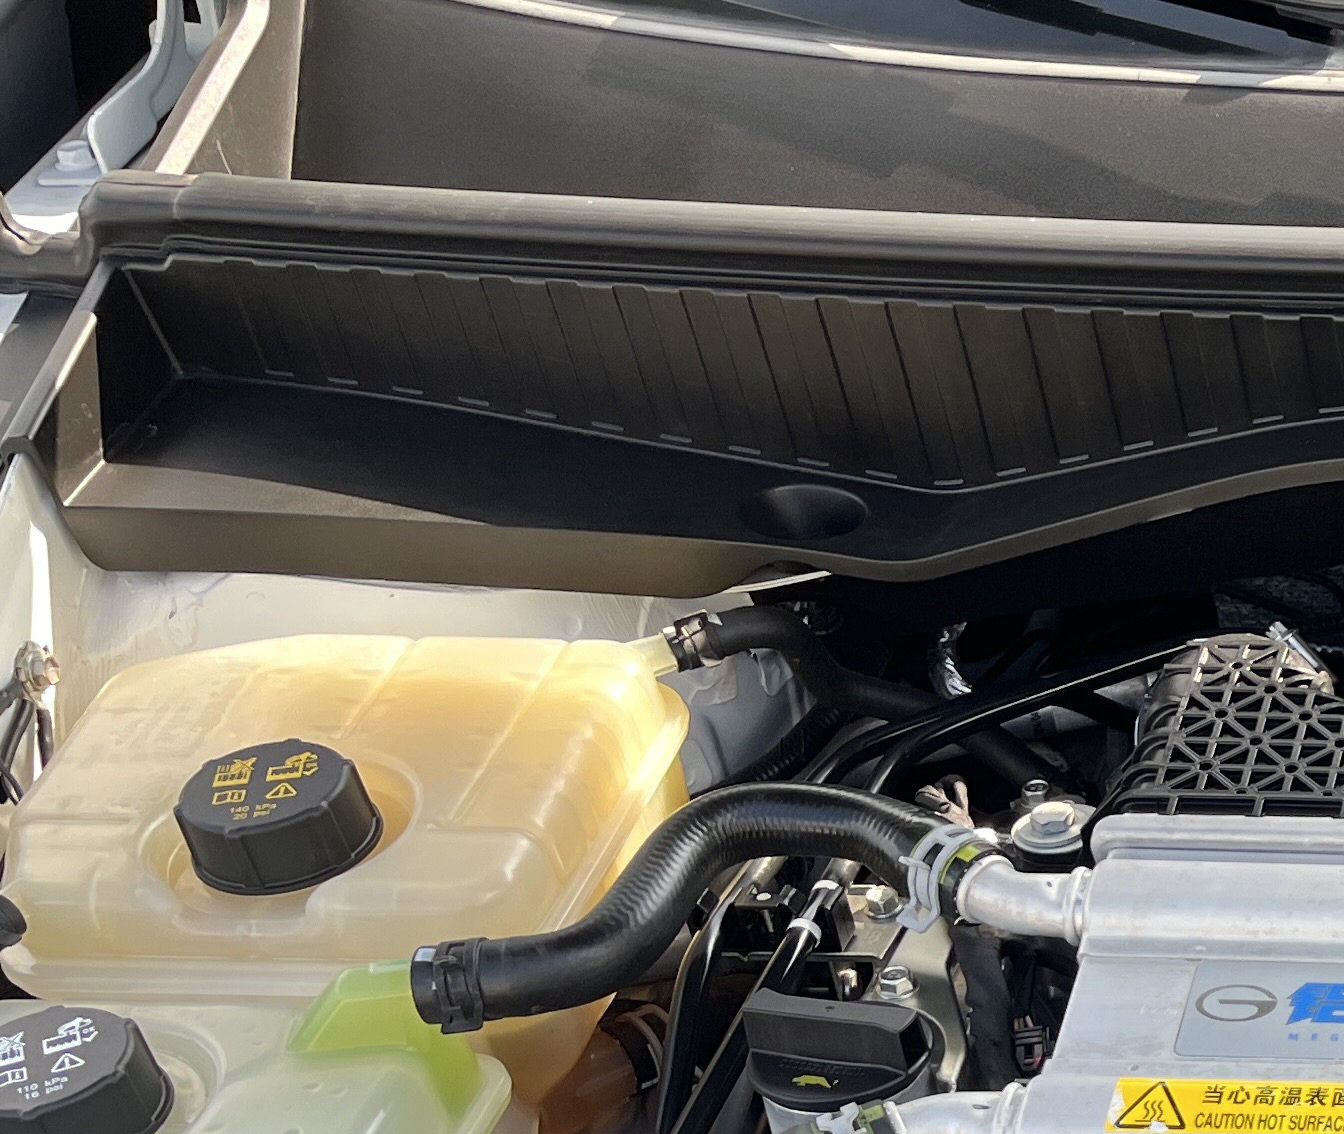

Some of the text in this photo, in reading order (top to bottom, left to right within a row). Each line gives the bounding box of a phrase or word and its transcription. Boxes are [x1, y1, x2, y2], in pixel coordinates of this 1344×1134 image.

[16, 1076, 68, 1094] 110 kPa
[45, 1083, 64, 1094] psi
[1195, 1113, 1255, 1130] CAUTION
[1257, 1114, 1286, 1131] HOT
